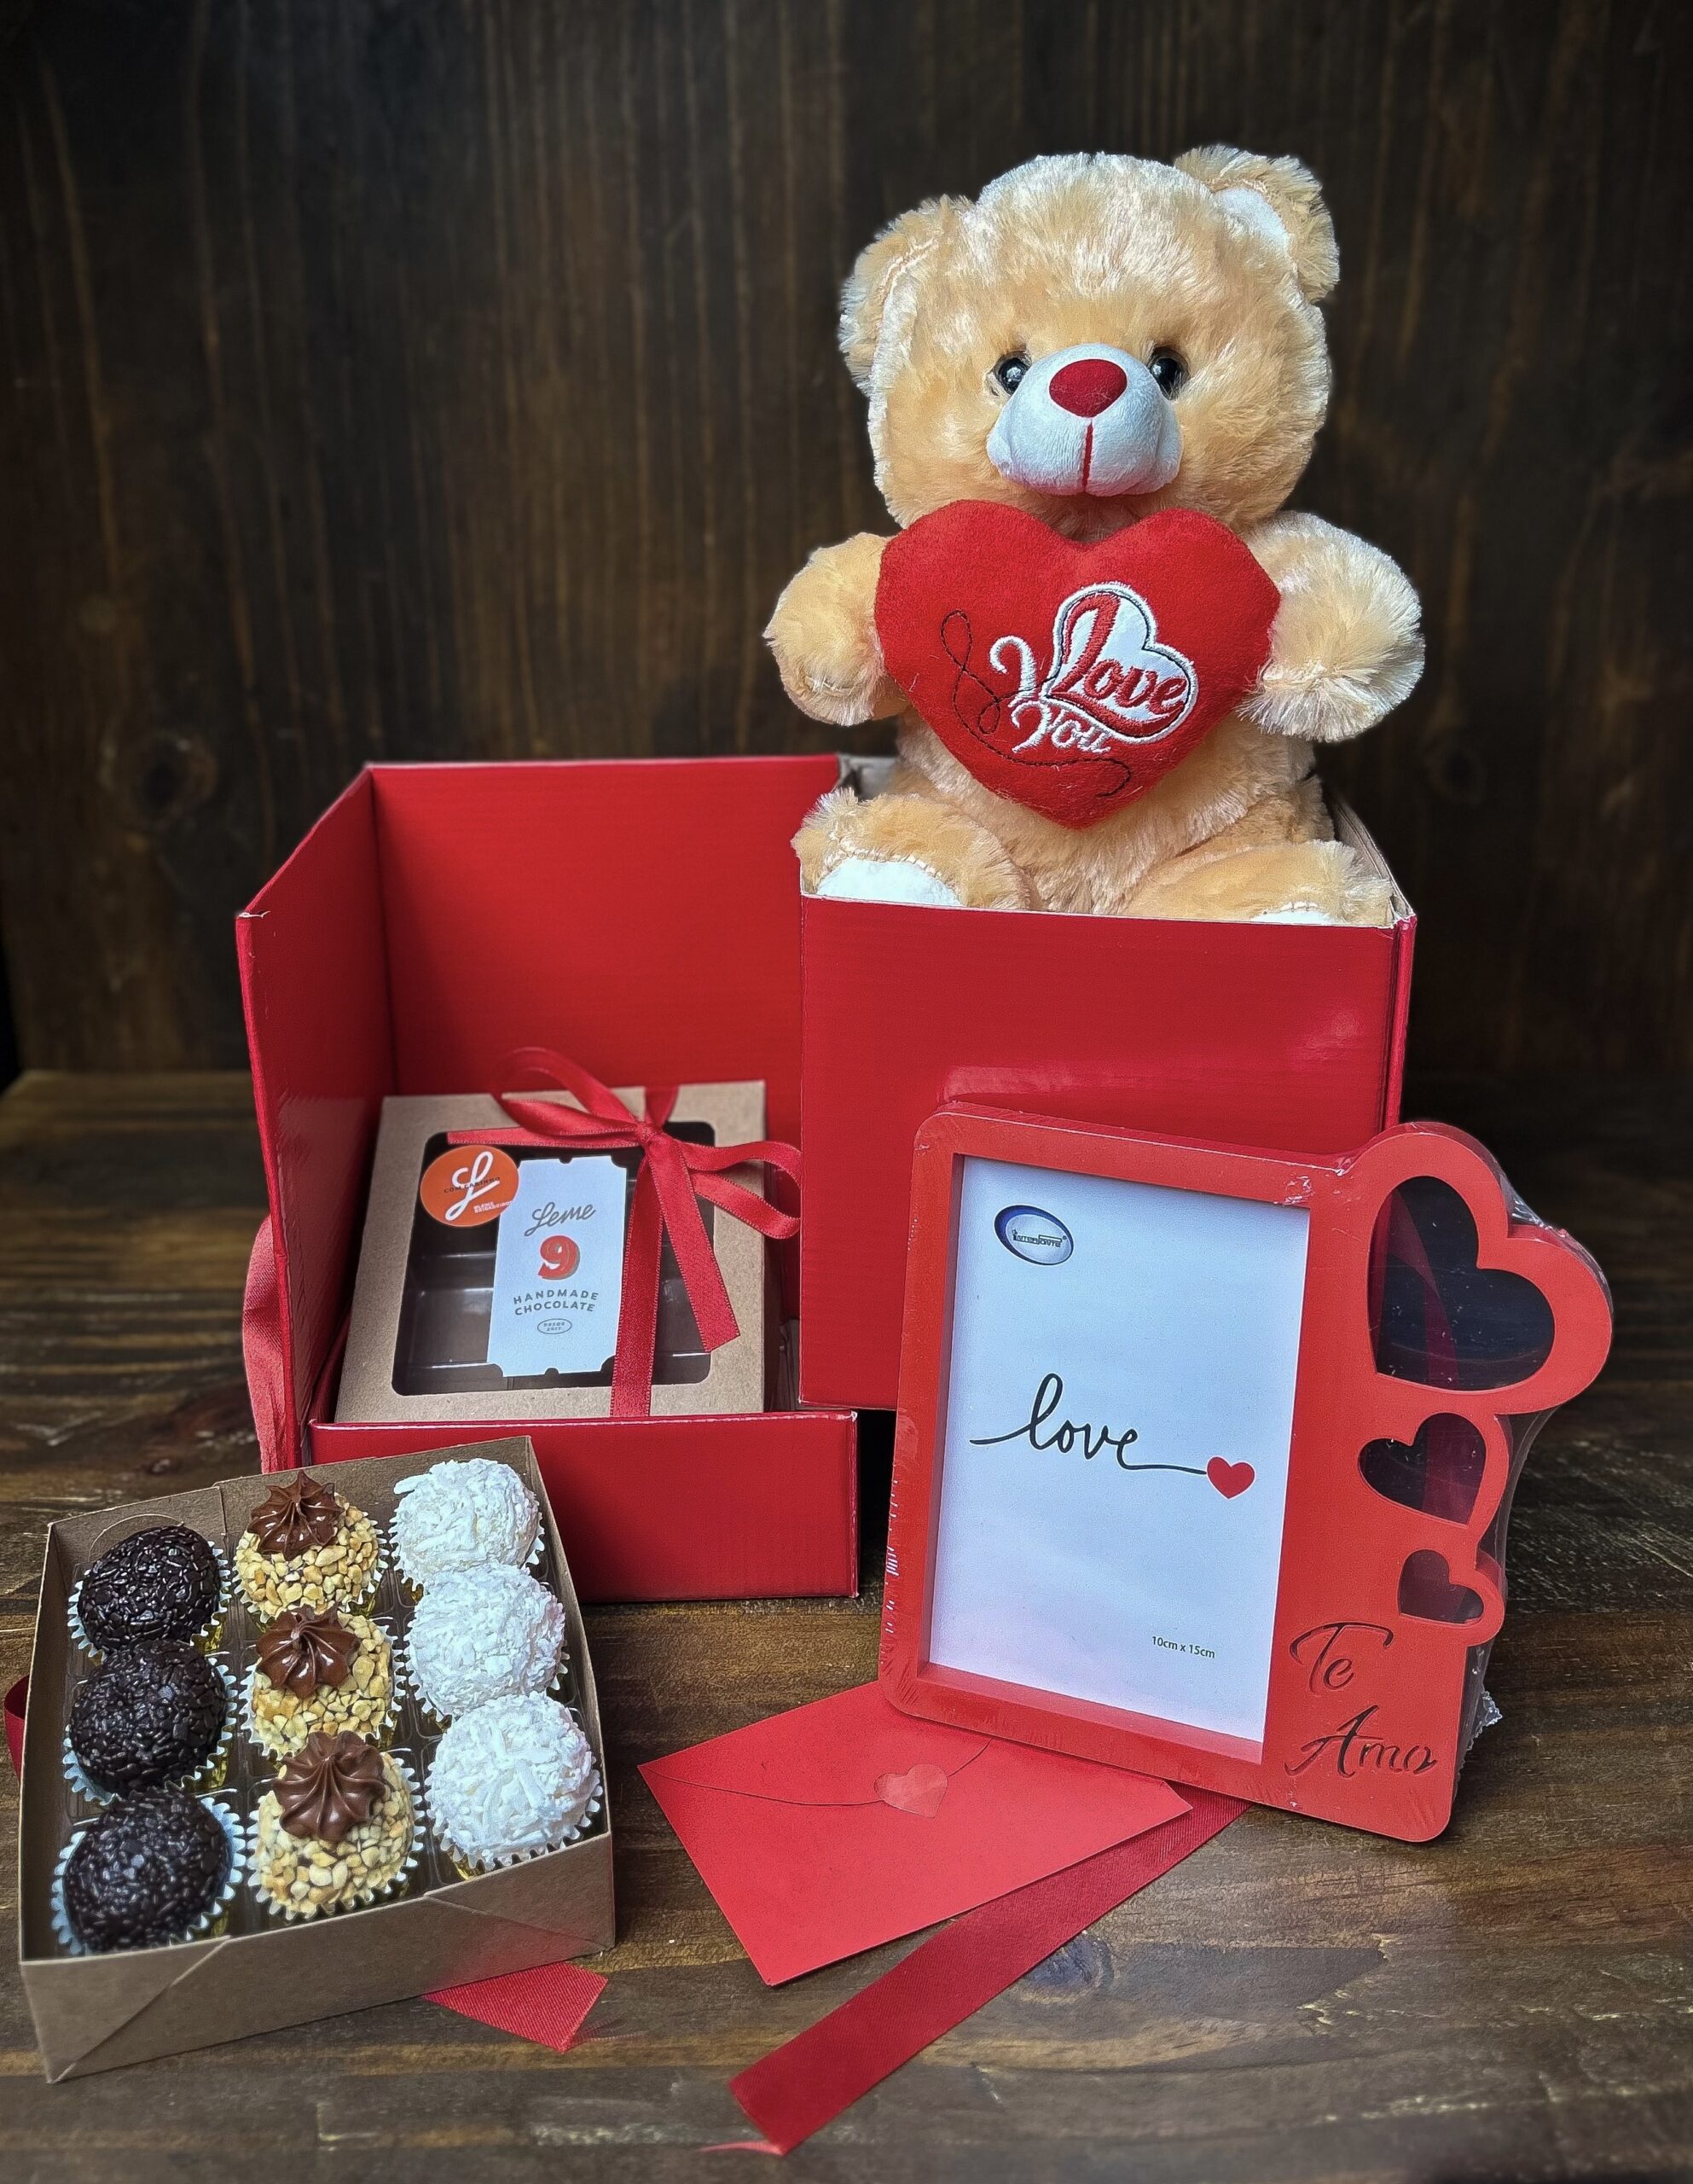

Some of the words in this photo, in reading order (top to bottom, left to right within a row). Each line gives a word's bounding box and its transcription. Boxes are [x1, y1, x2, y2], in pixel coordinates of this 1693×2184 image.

[1050, 593, 1191, 737] Love
[1011, 700, 1112, 753] You
[524, 1201, 596, 1236] Leme
[537, 1234, 580, 1280] 9
[513, 1289, 599, 1304] HANDMADE
[514, 1300, 595, 1316] CHOCOLATE
[1152, 1636, 1178, 1650] 10cm
[1189, 1645, 1215, 1658] 15cm
[1290, 1621, 1394, 1695] Te
[1284, 1704, 1437, 1779] Amo
